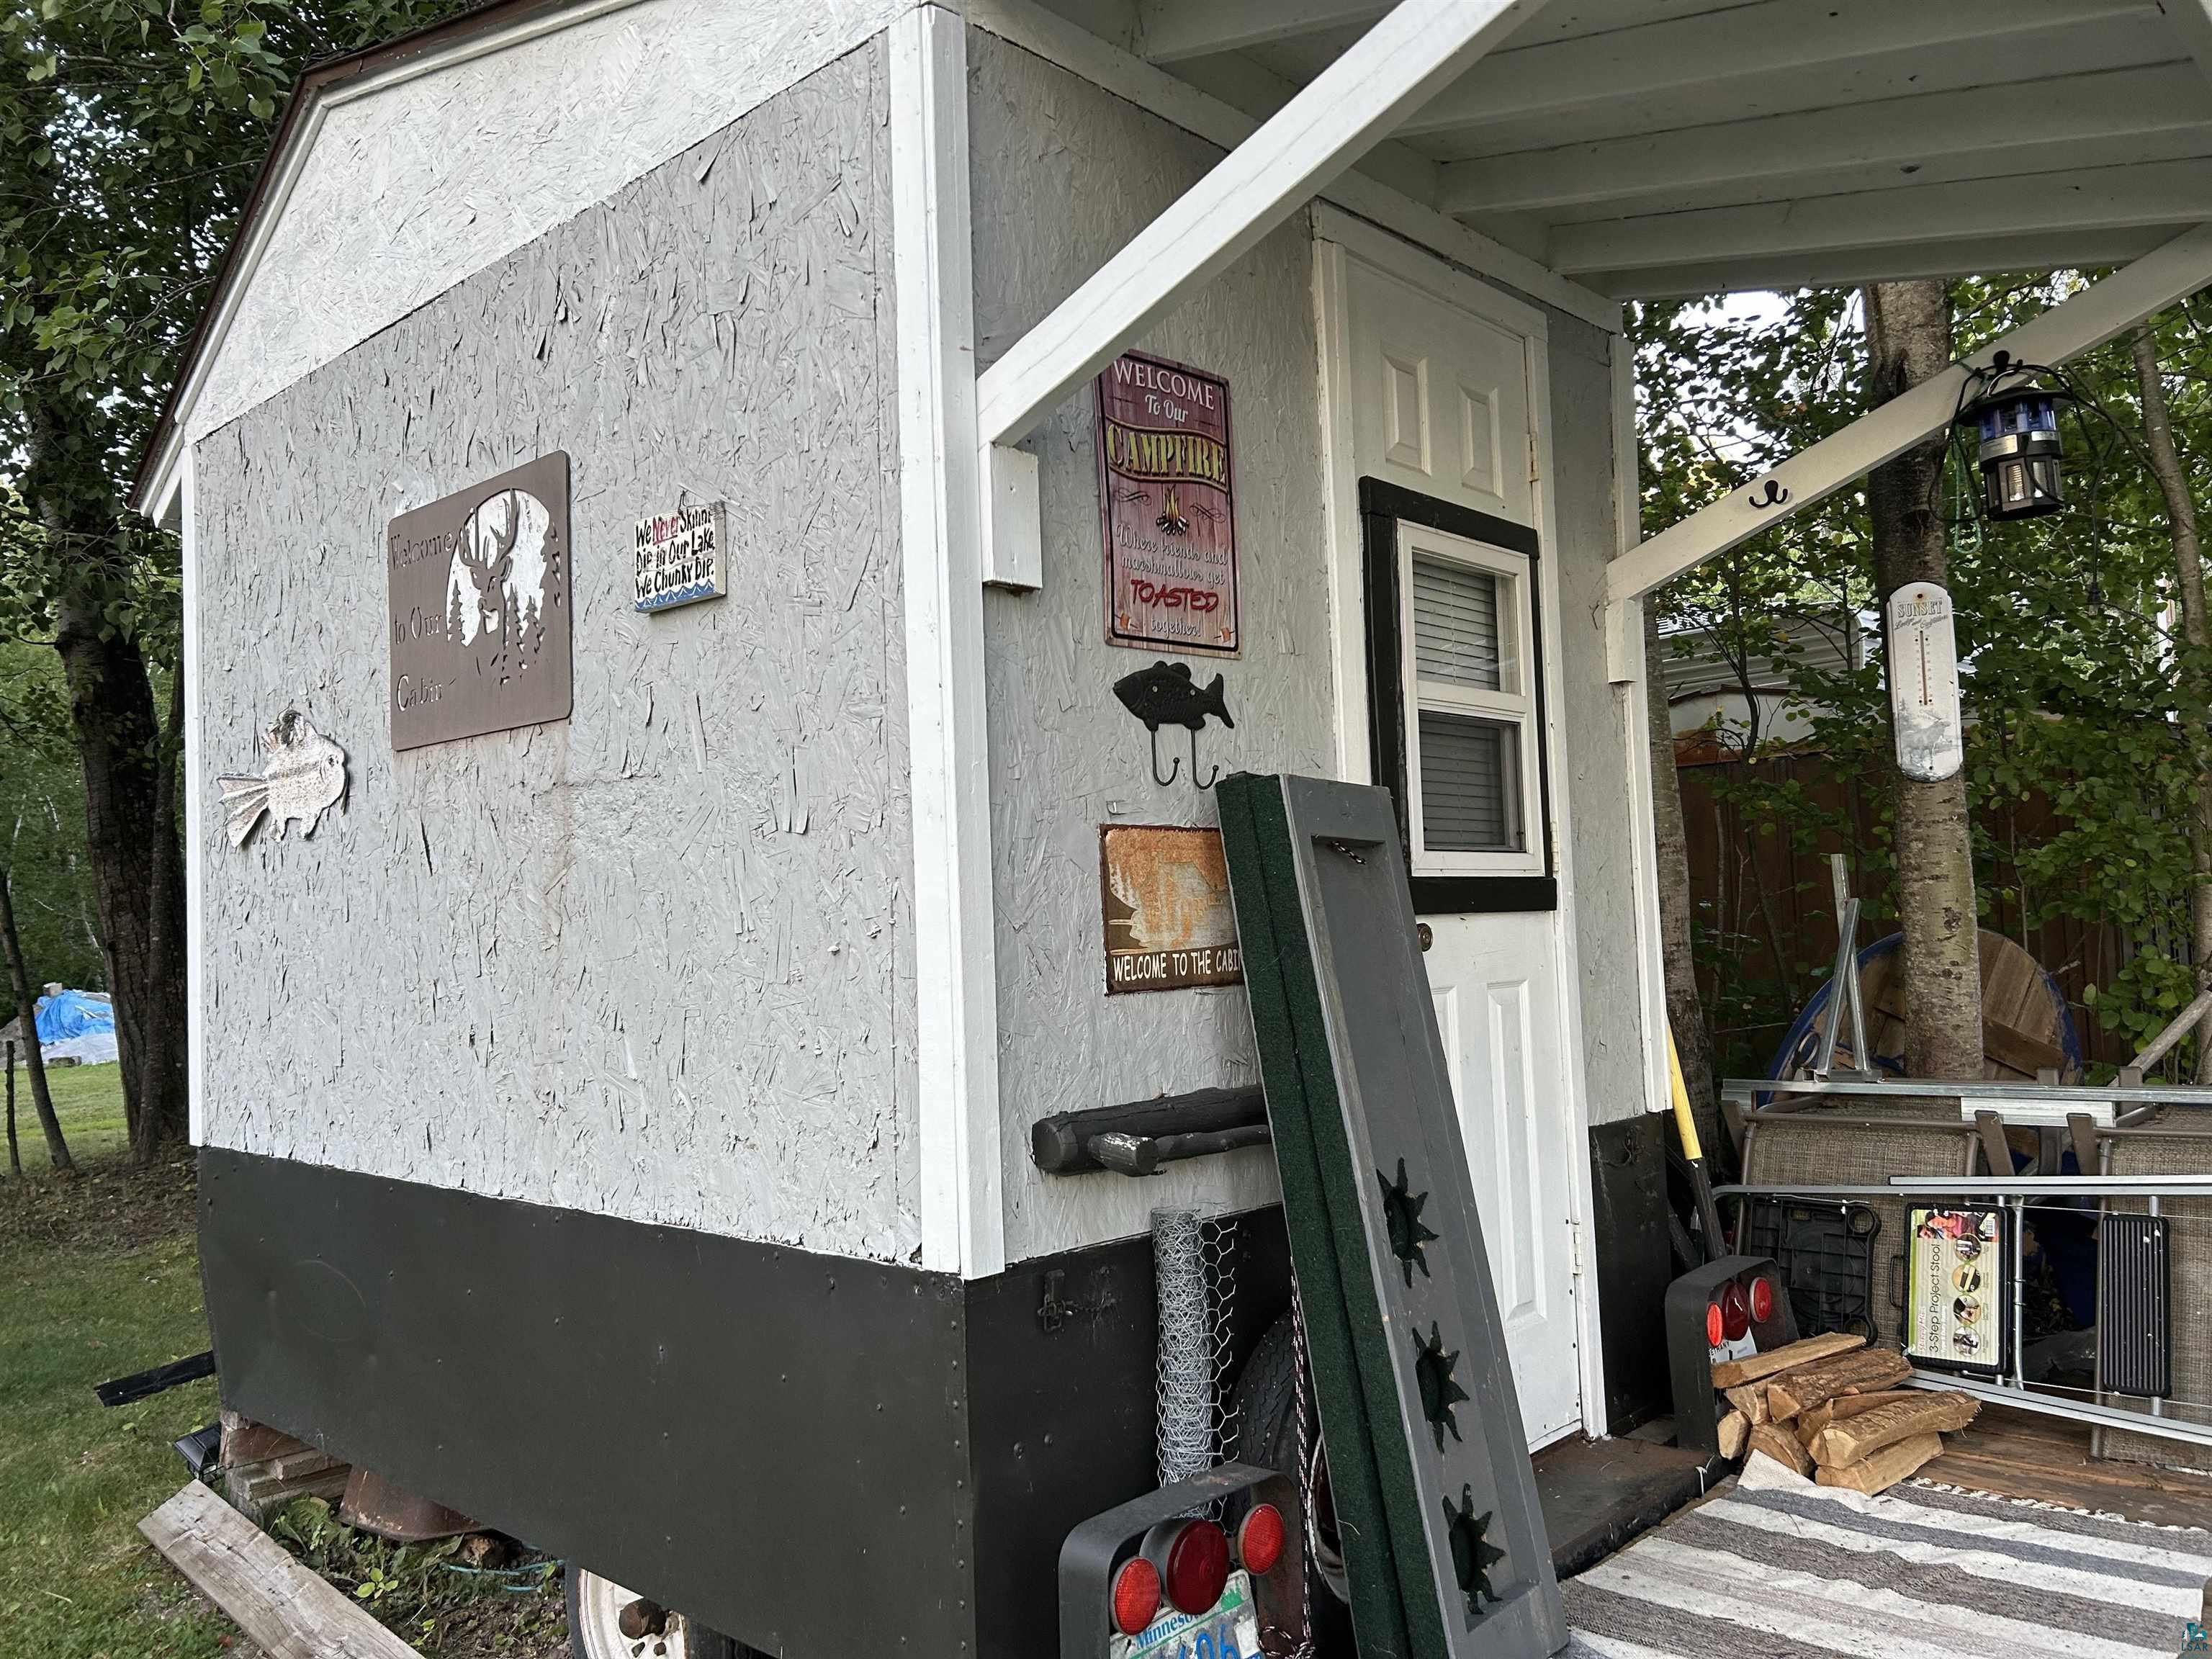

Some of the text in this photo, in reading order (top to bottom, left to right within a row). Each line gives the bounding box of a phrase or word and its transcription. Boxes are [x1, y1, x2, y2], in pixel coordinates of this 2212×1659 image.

[1114, 360, 1215, 410] WELCOME
[1145, 394, 1188, 423] To Our
[1107, 423, 1227, 485] CAMPFIRE
[636, 519, 651, 549] We
[652, 516, 678, 547] Never
[1116, 523, 1228, 565] Where friends and
[391, 531, 452, 570] Welcome
[656, 544, 666, 569] in
[668, 540, 690, 565] Our
[635, 575, 652, 599] We
[1121, 555, 1226, 589] marshmallows get
[1130, 579, 1218, 613] TOASTED
[1897, 600, 1943, 618] SUNSET
[410, 606, 442, 639] Our
[397, 674, 444, 712] Cabin
[1113, 953, 1166, 981] WELCOME
[1172, 953, 1187, 976] TO
[1190, 949, 1211, 975] THE
[1930, 1244, 1941, 1352] 3-Step Project Stool
[1136, 1610, 1199, 1649] Minneso
